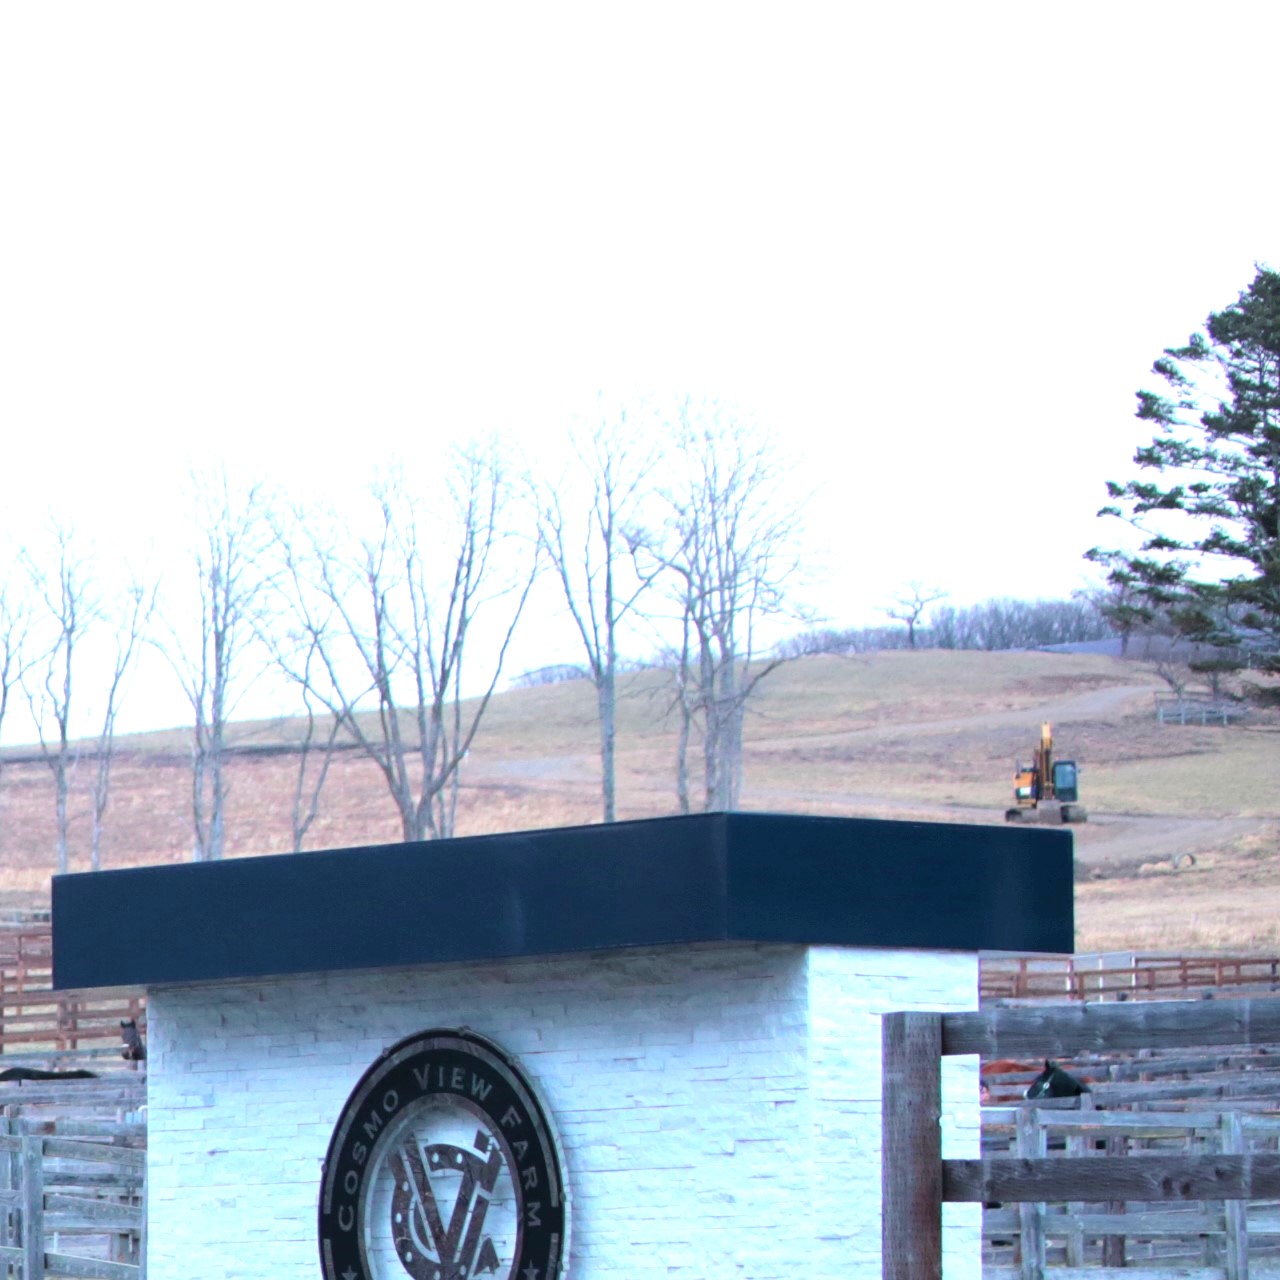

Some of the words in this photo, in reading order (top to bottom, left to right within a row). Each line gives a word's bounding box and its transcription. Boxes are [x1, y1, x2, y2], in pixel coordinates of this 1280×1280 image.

[338, 1090, 399, 1232] COSMO
[413, 1063, 493, 1101] VIEW
[500, 1104, 542, 1227] FARM
